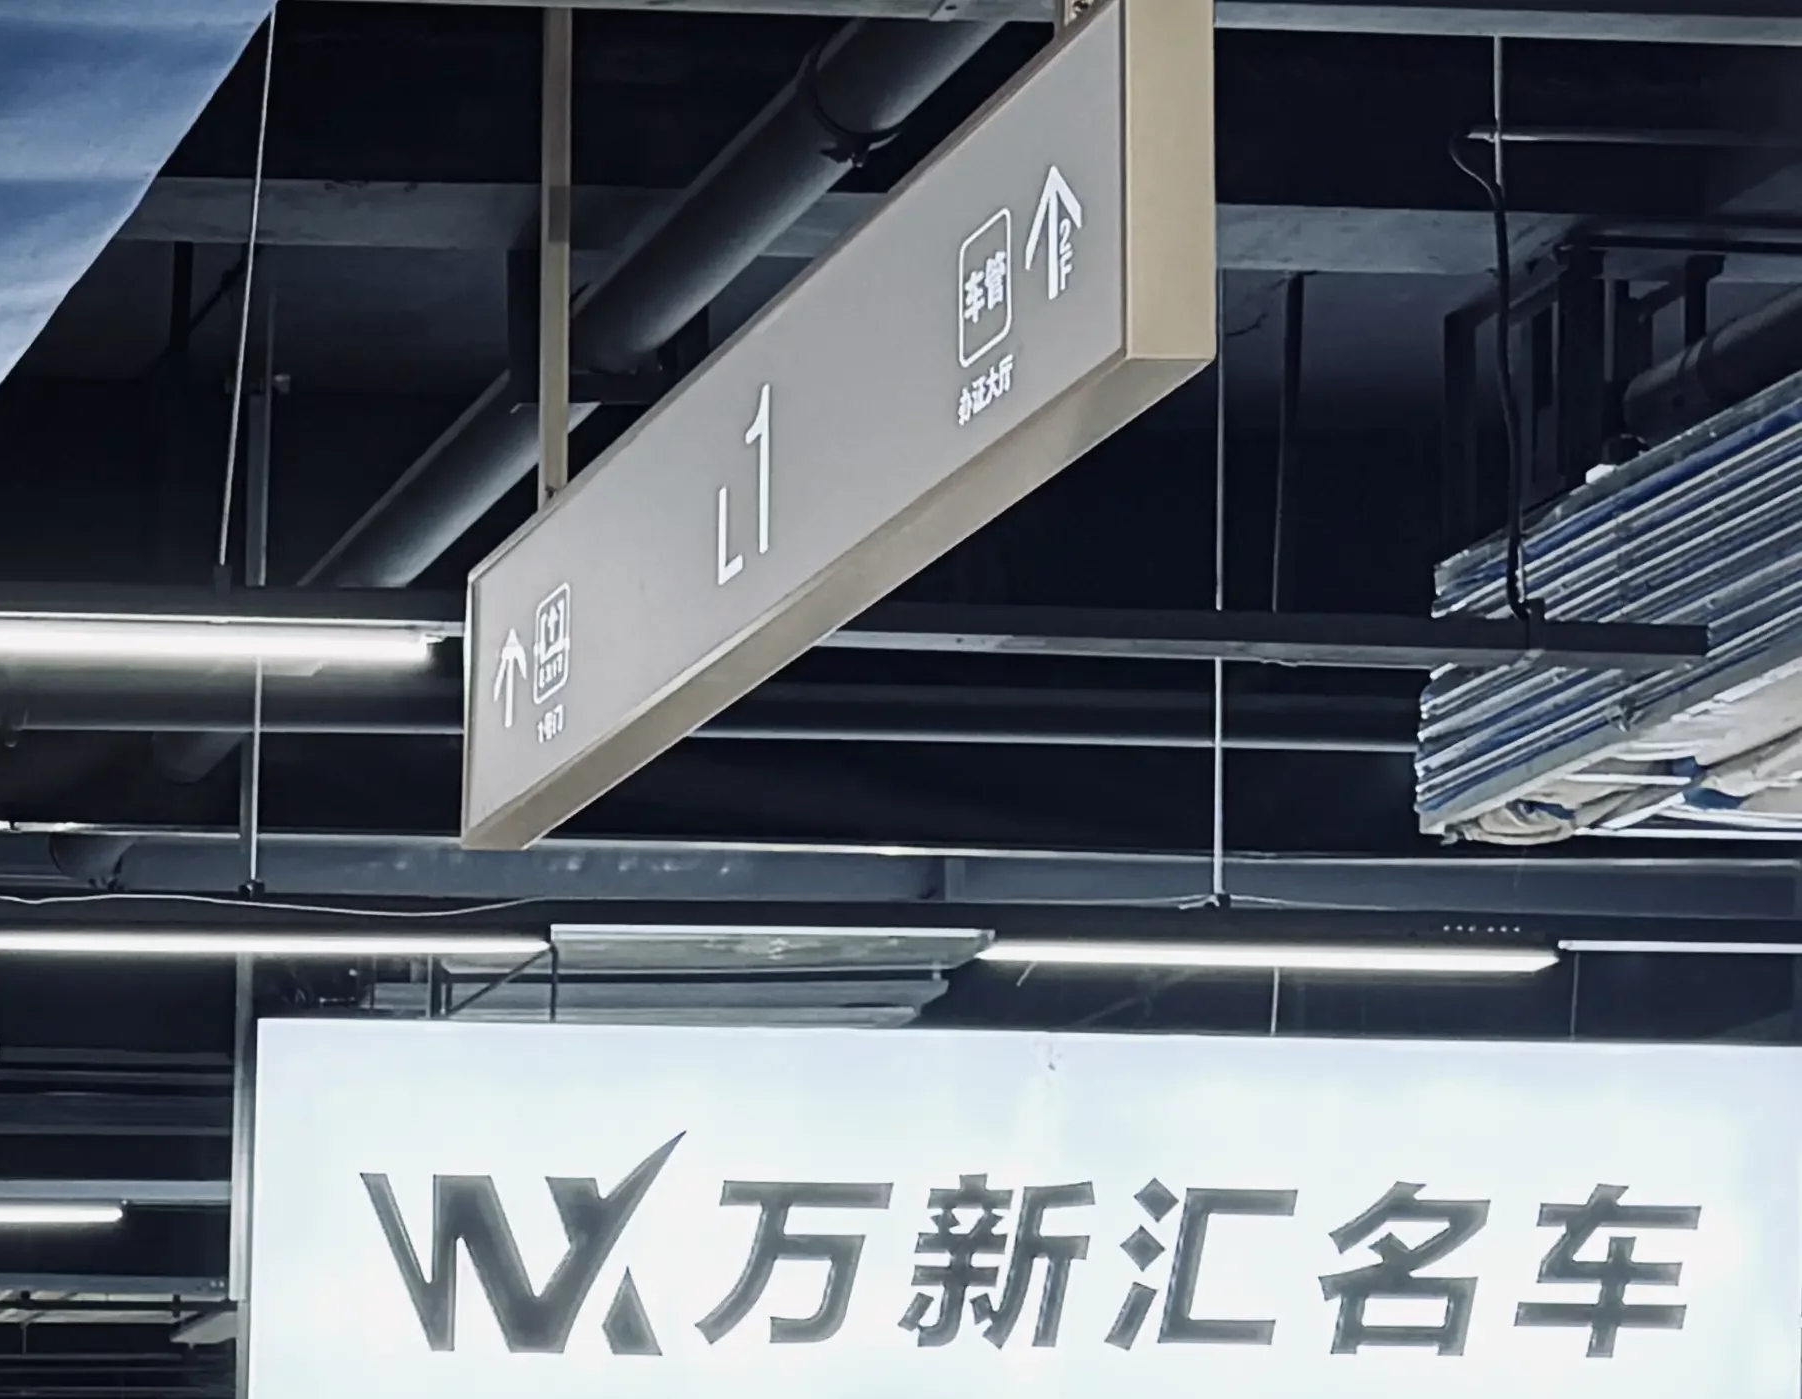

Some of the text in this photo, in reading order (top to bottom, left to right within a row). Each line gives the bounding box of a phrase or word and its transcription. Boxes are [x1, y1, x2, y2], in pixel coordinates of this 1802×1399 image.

[963, 250, 1007, 324] 车管
[958, 353, 1013, 426] 办证大厅
[717, 383, 772, 586] L1
[694, 1172, 1704, 1360] 万新汇名车
